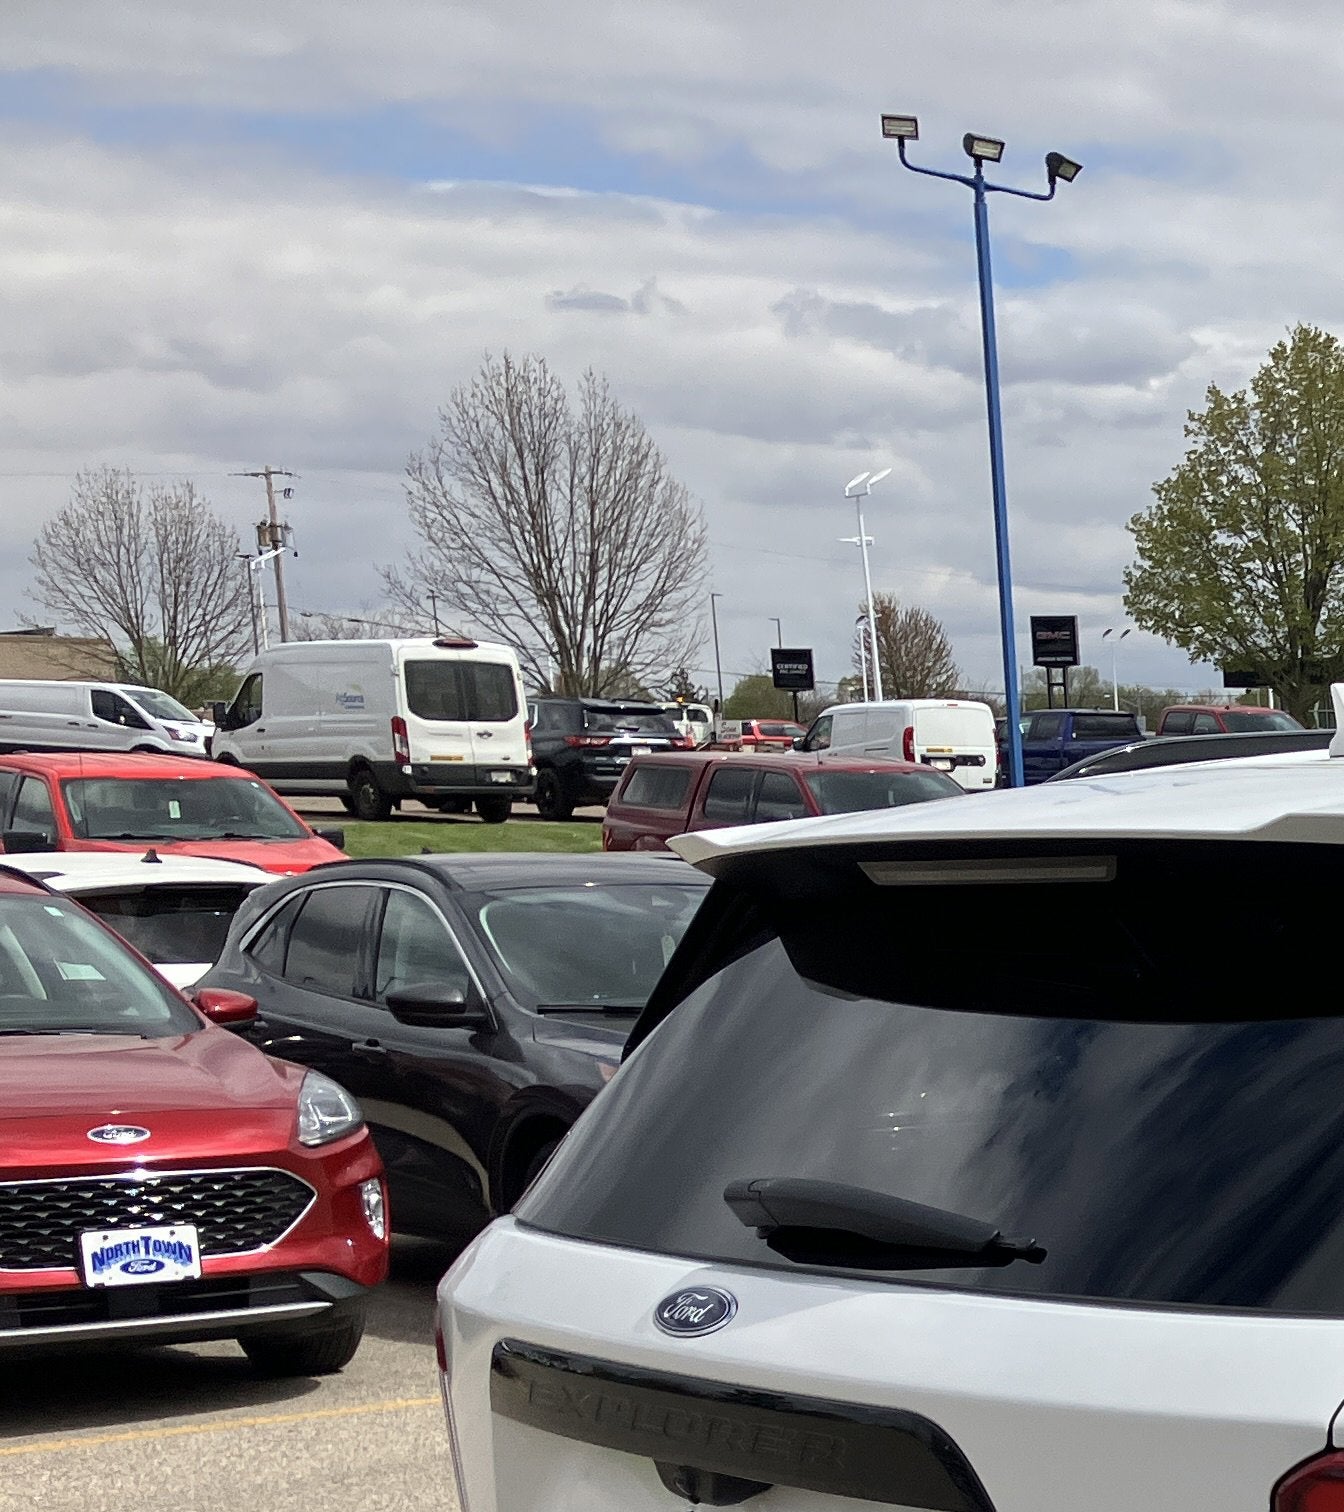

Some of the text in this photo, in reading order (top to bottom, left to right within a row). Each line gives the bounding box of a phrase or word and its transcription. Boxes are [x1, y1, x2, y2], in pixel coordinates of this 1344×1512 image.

[127, 1260, 158, 1273] Ford
[662, 1292, 714, 1324] Ford
[525, 1378, 846, 1466] EXPLORER
